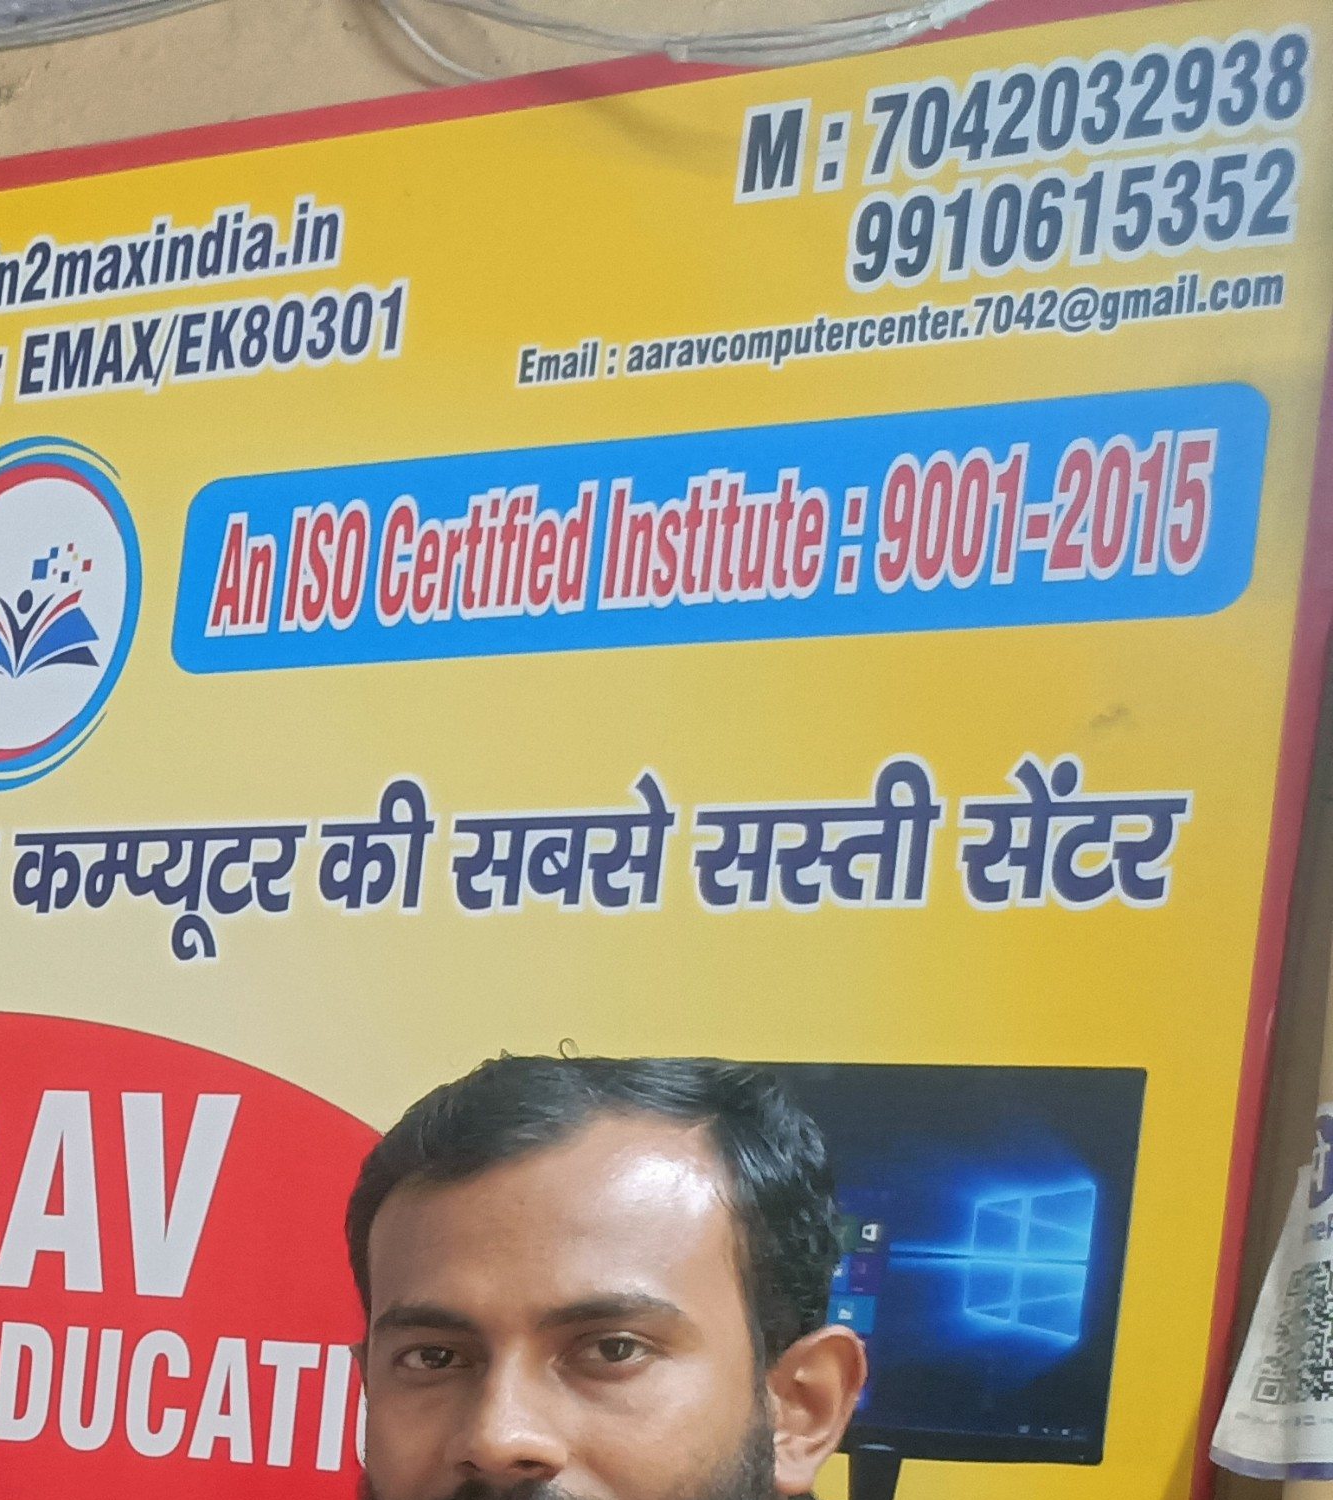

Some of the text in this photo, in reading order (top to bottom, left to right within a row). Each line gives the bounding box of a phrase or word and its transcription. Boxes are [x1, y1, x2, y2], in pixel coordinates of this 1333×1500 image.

[742, 107, 804, 194] M
[870, 33, 1309, 179] 7042032938
[852, 147, 1297, 285] 9910615352
[20, 287, 404, 393] EMAX/EK80301
[519, 340, 597, 384] Email
[626, 273, 1284, 374] aaravcomputercenter.7042@gmail.com
[211, 522, 273, 628] An
[288, 504, 361, 623] ISO
[378, 485, 591, 622] Certified
[603, 473, 825, 602] Institute
[879, 432, 1214, 590] 9001-2015
[13, 825, 307, 960] कम्प्यूटर
[319, 779, 435, 909] की
[454, 773, 675, 908] सबसे
[695, 760, 940, 905] सस्ती
[962, 758, 1188, 902] सेंटर
